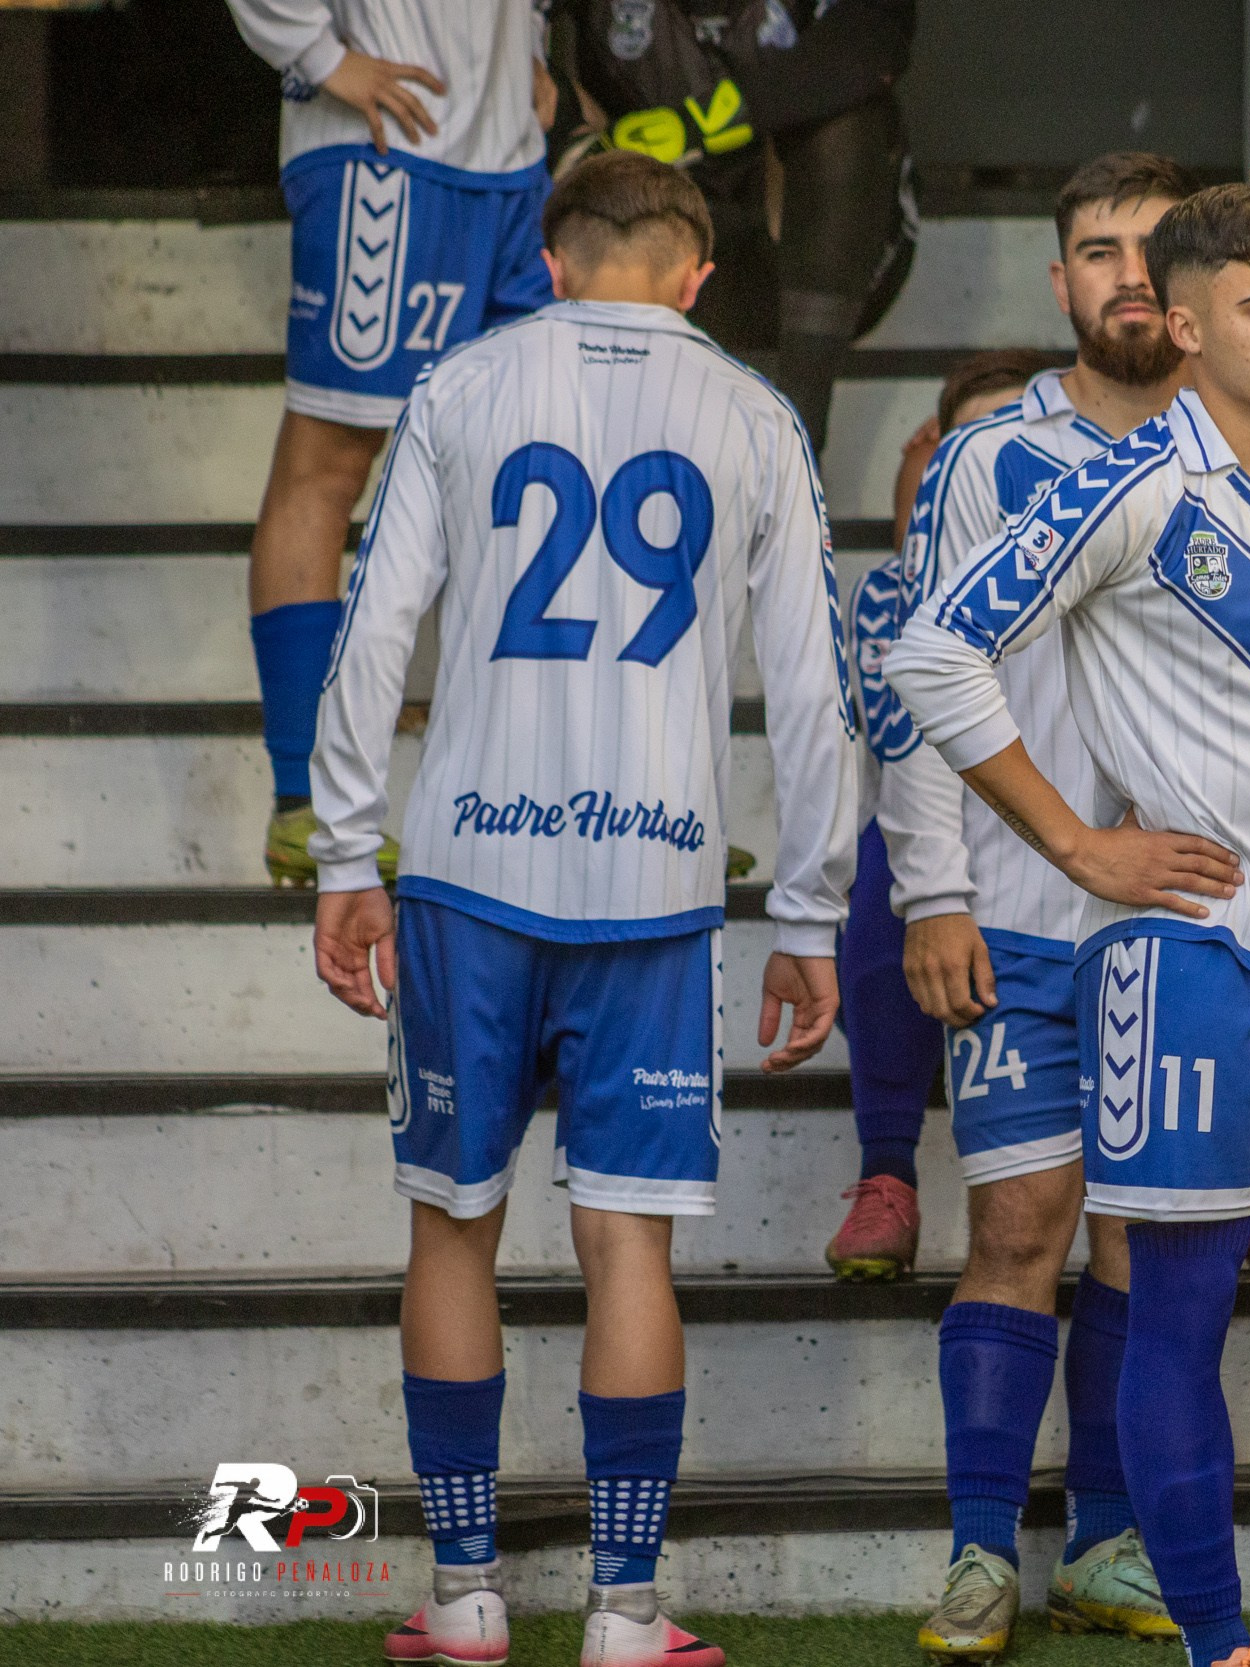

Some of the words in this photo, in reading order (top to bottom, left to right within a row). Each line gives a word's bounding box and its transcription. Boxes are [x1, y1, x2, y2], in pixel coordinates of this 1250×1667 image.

[404, 281, 465, 350] 27
[489, 441, 715, 669] 29
[453, 791, 567, 837] Padre
[567, 790, 705, 852] Hurtado
[632, 1067, 668, 1087] Padre
[952, 1022, 1027, 1101] 24
[1159, 1054, 1216, 1133] 11
[427, 1095, 455, 1116] 1912
